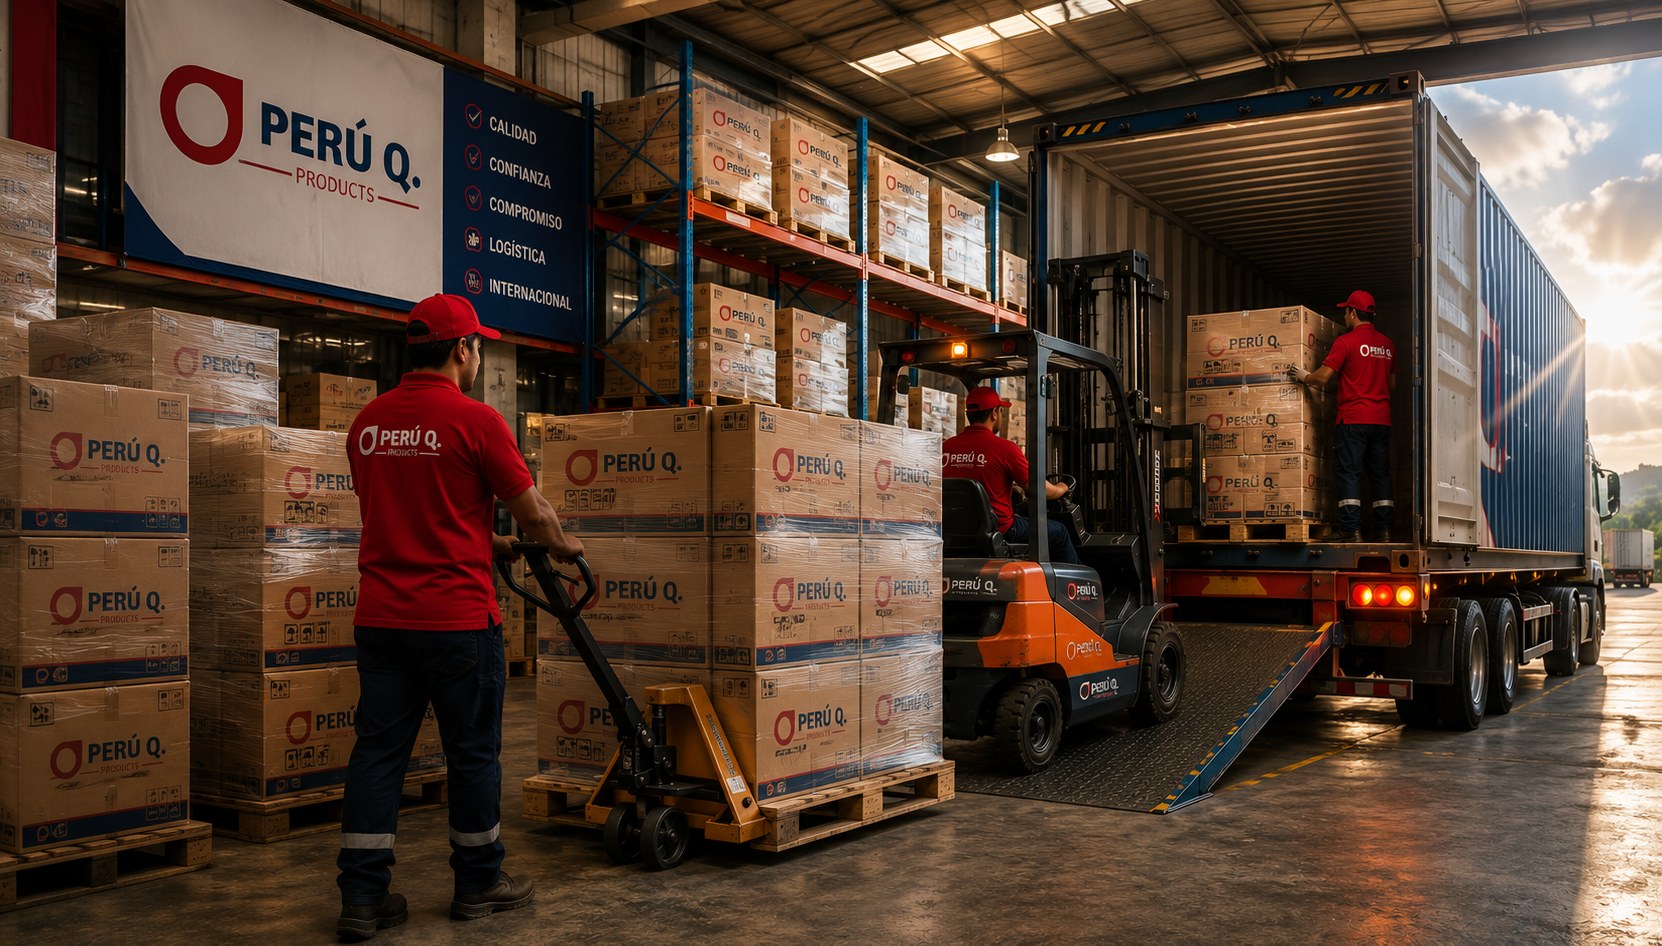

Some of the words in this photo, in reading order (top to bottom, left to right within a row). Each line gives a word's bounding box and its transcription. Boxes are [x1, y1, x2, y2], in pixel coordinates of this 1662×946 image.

[489, 115, 537, 146] CALIDAD
[261, 101, 372, 173] PERÚ
[384, 142, 422, 194] Q.
[296, 167, 375, 203] PRODUCTS
[489, 156, 552, 190] CONFIANZA
[489, 196, 563, 231] COMPROMISO
[489, 236, 546, 266] LOGÍSTICA
[489, 278, 573, 312] INTERNACIONAL
[1229, 333, 1263, 350] PERÚ
[1267, 335, 1280, 349] Q.
[202, 355, 240, 374] PERÚ
[380, 425, 420, 446] PERÚ
[424, 430, 442, 451] Q.
[88, 437, 140, 462] PERÚ
[146, 444, 165, 468] Q.
[604, 447, 655, 472] PERÚ
[662, 452, 682, 474] Q.
[951, 451, 975, 463] PERÚ
[101, 464, 139, 473] PRODUCTS
[797, 453, 831, 475] PERÚ
[834, 459, 846, 480] Q.
[606, 575, 657, 600] PERÚ
[663, 581, 683, 604] Q.
[798, 577, 831, 600] PERÚ
[834, 582, 846, 602] Q.
[894, 576, 920, 596] PERÚ
[952, 576, 981, 590] PERÚ
[88, 586, 140, 612] PERÚ
[146, 591, 165, 614] Q.
[316, 586, 356, 608] PERÚ
[101, 615, 139, 624] PRODUCTS
[316, 705, 355, 731] PERÚ
[798, 704, 831, 731] PERÚ
[834, 707, 847, 727] Q.
[88, 733, 140, 764] PERÚ
[146, 736, 166, 759] Q.
[101, 762, 139, 775] PRODUCTS
